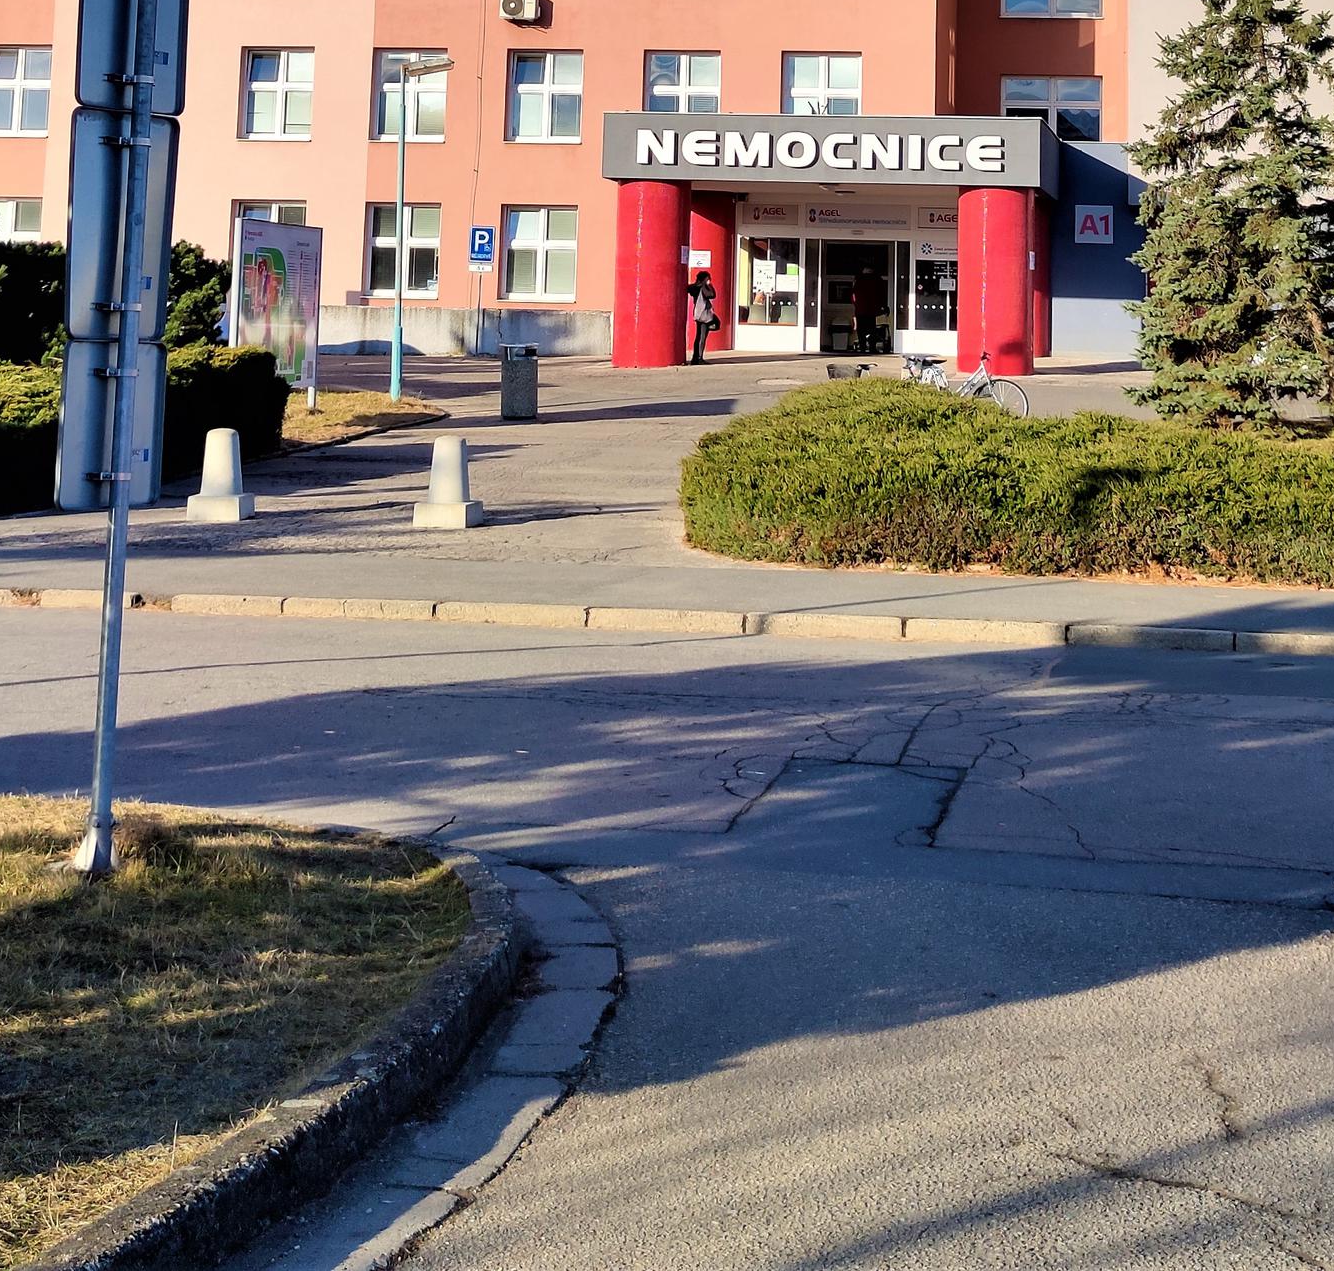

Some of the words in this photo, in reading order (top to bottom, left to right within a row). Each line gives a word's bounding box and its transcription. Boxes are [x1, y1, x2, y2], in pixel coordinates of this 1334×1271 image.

[636, 129, 1005, 172] NEMOCNICE
[762, 207, 787, 216] AGEL
[818, 209, 841, 217] AGEL
[936, 214, 958, 222] AGE
[1079, 214, 1110, 235] A1
[474, 230, 490, 252] P
